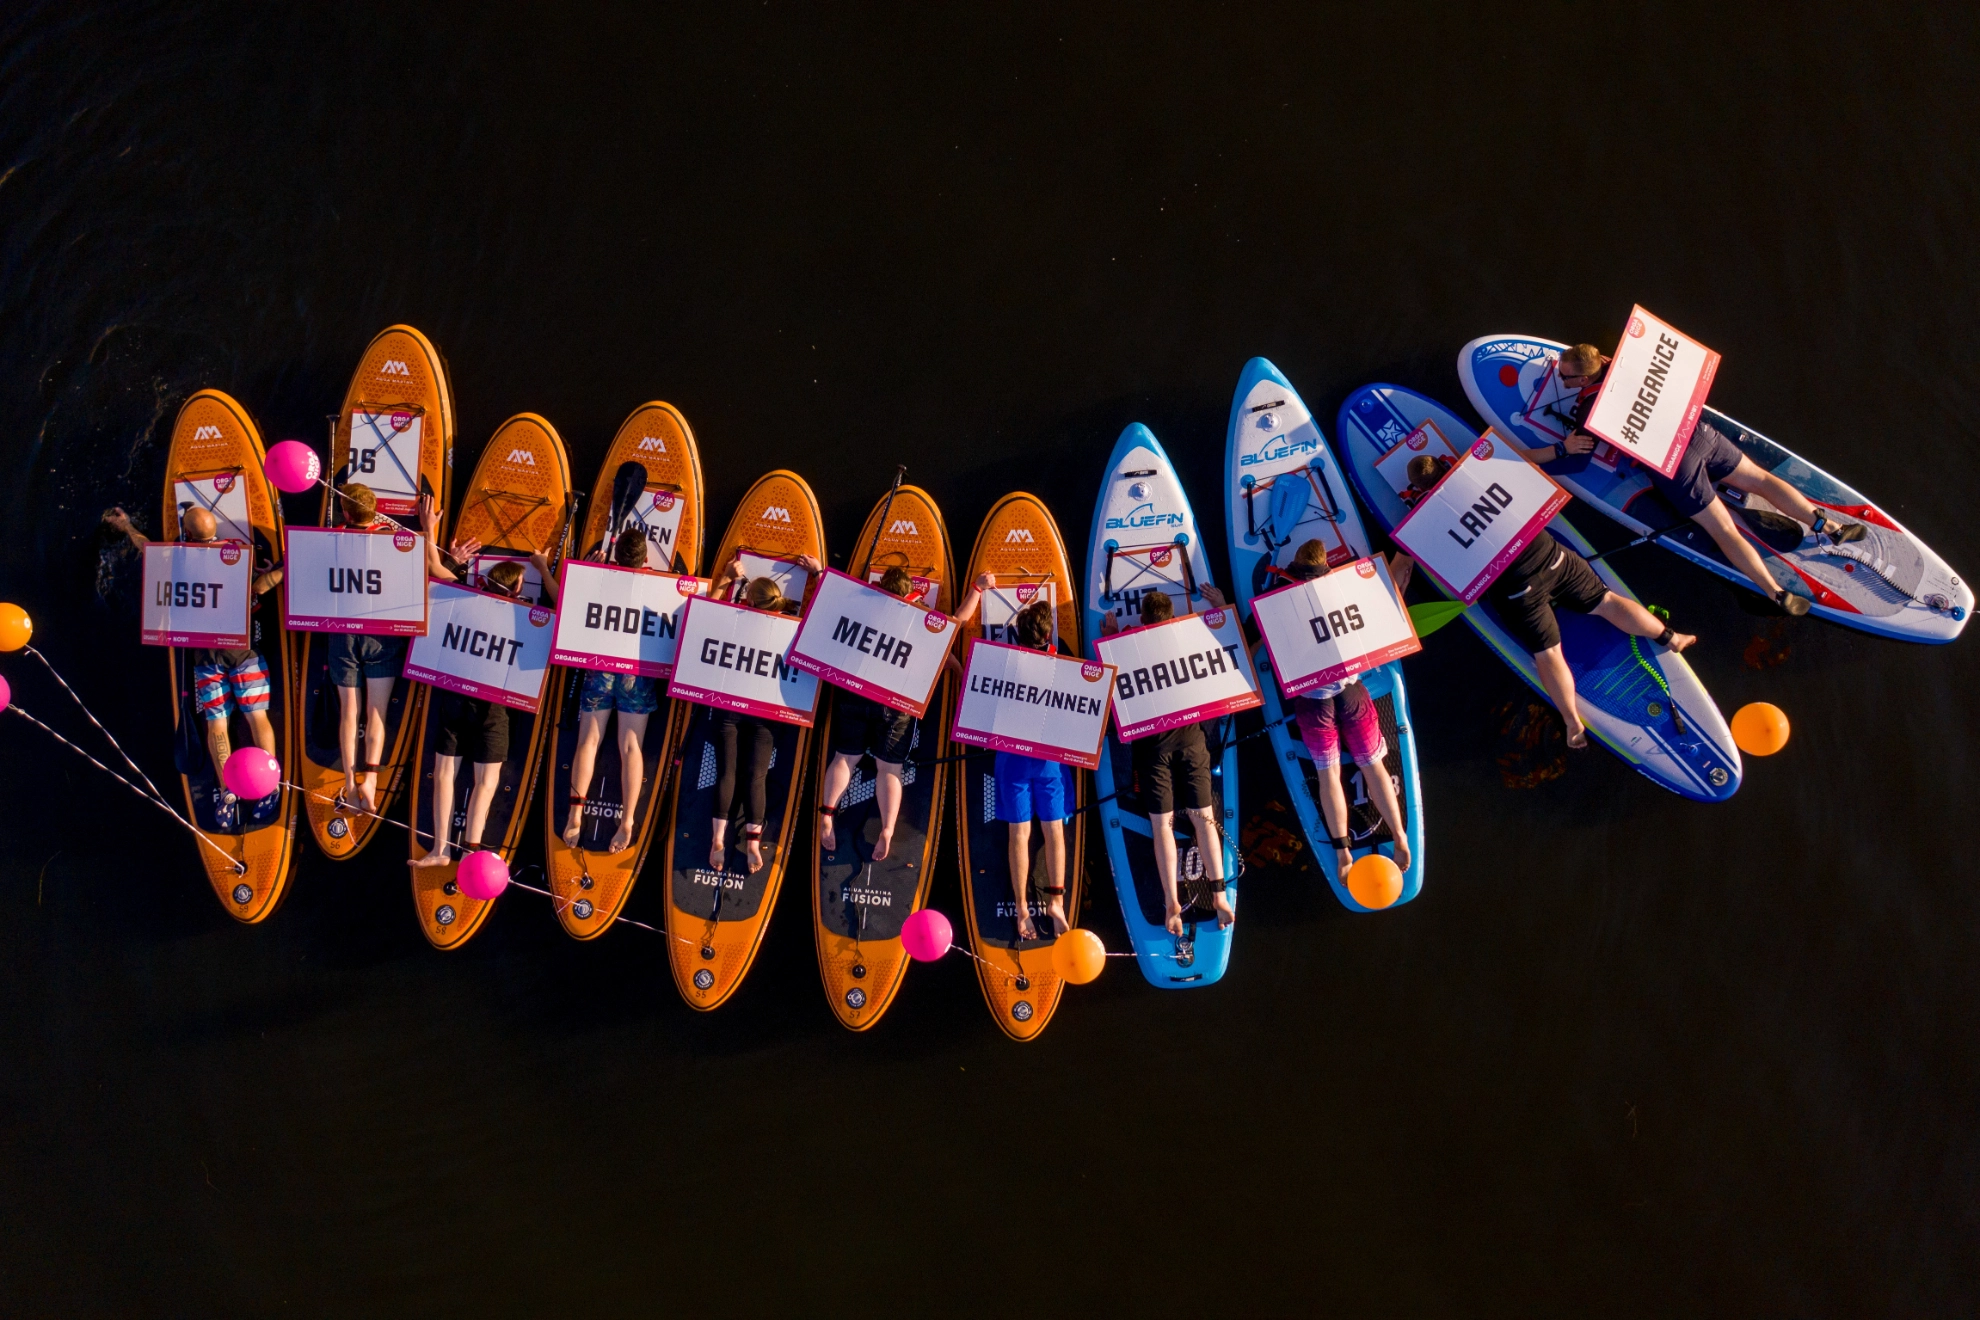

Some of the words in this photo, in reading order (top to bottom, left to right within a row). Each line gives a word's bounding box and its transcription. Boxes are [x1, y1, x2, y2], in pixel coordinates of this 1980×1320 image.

[1448, 482, 1513, 549] LAND
[156, 581, 223, 608] LASST
[329, 568, 381, 594] UNS
[585, 602, 678, 639] BADEN
[1309, 604, 1364, 644] DAS
[442, 623, 524, 665] NICHT
[700, 638, 800, 684] GEHEN!
[832, 616, 912, 669] MEHR
[1116, 643, 1239, 700] BRAUCHT
[971, 675, 1101, 716] LEHRER/INNEN
[584, 805, 623, 819] USION
[694, 874, 744, 890] FUSION
[842, 893, 891, 906] FUSION
